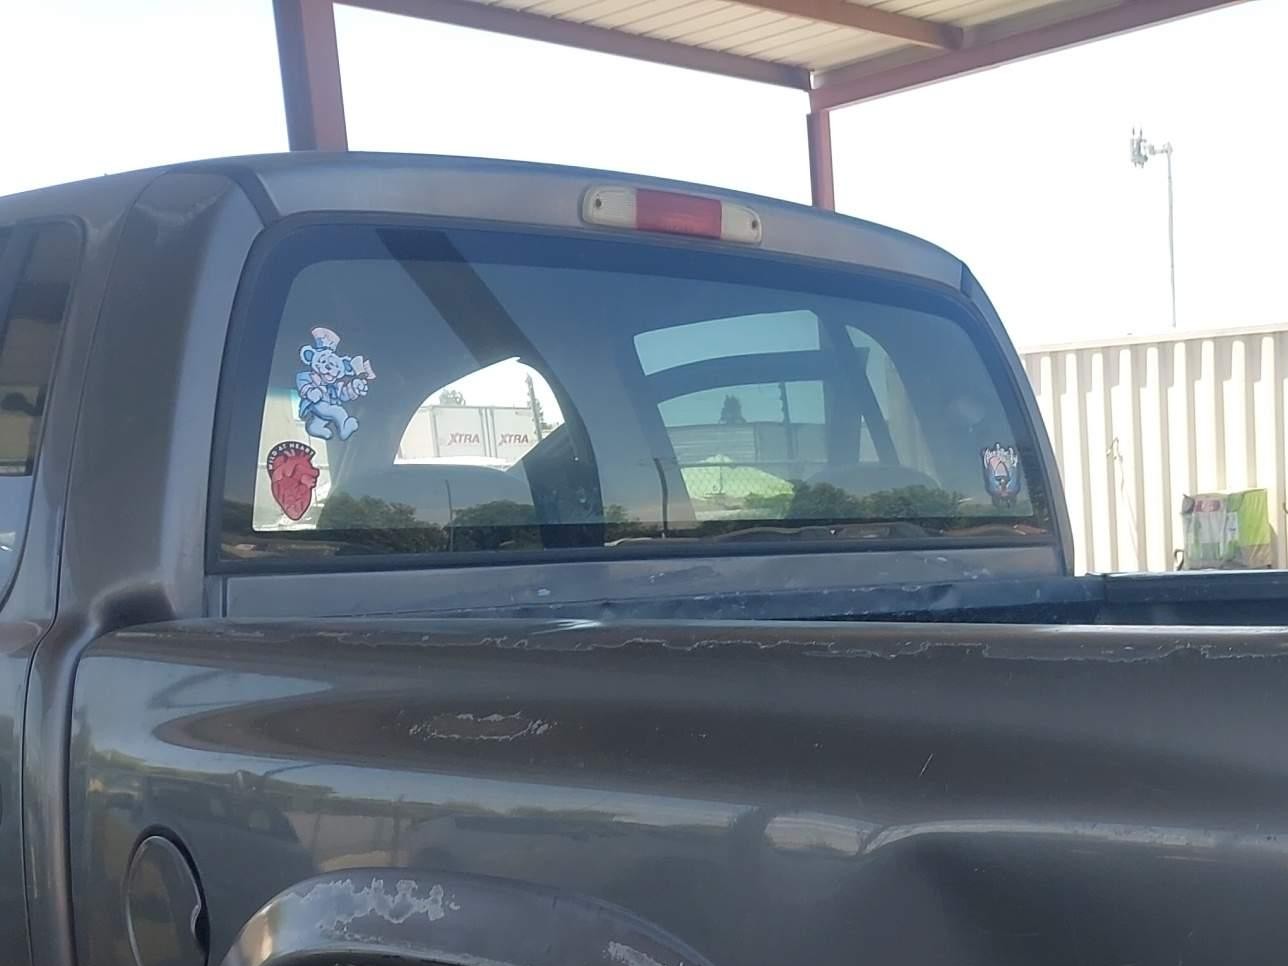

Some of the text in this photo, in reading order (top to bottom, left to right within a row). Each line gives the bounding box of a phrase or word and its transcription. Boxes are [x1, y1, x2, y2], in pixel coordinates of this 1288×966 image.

[448, 432, 480, 446] XTRA
[499, 432, 529, 446] XTRA
[289, 443, 314, 456] HEART
